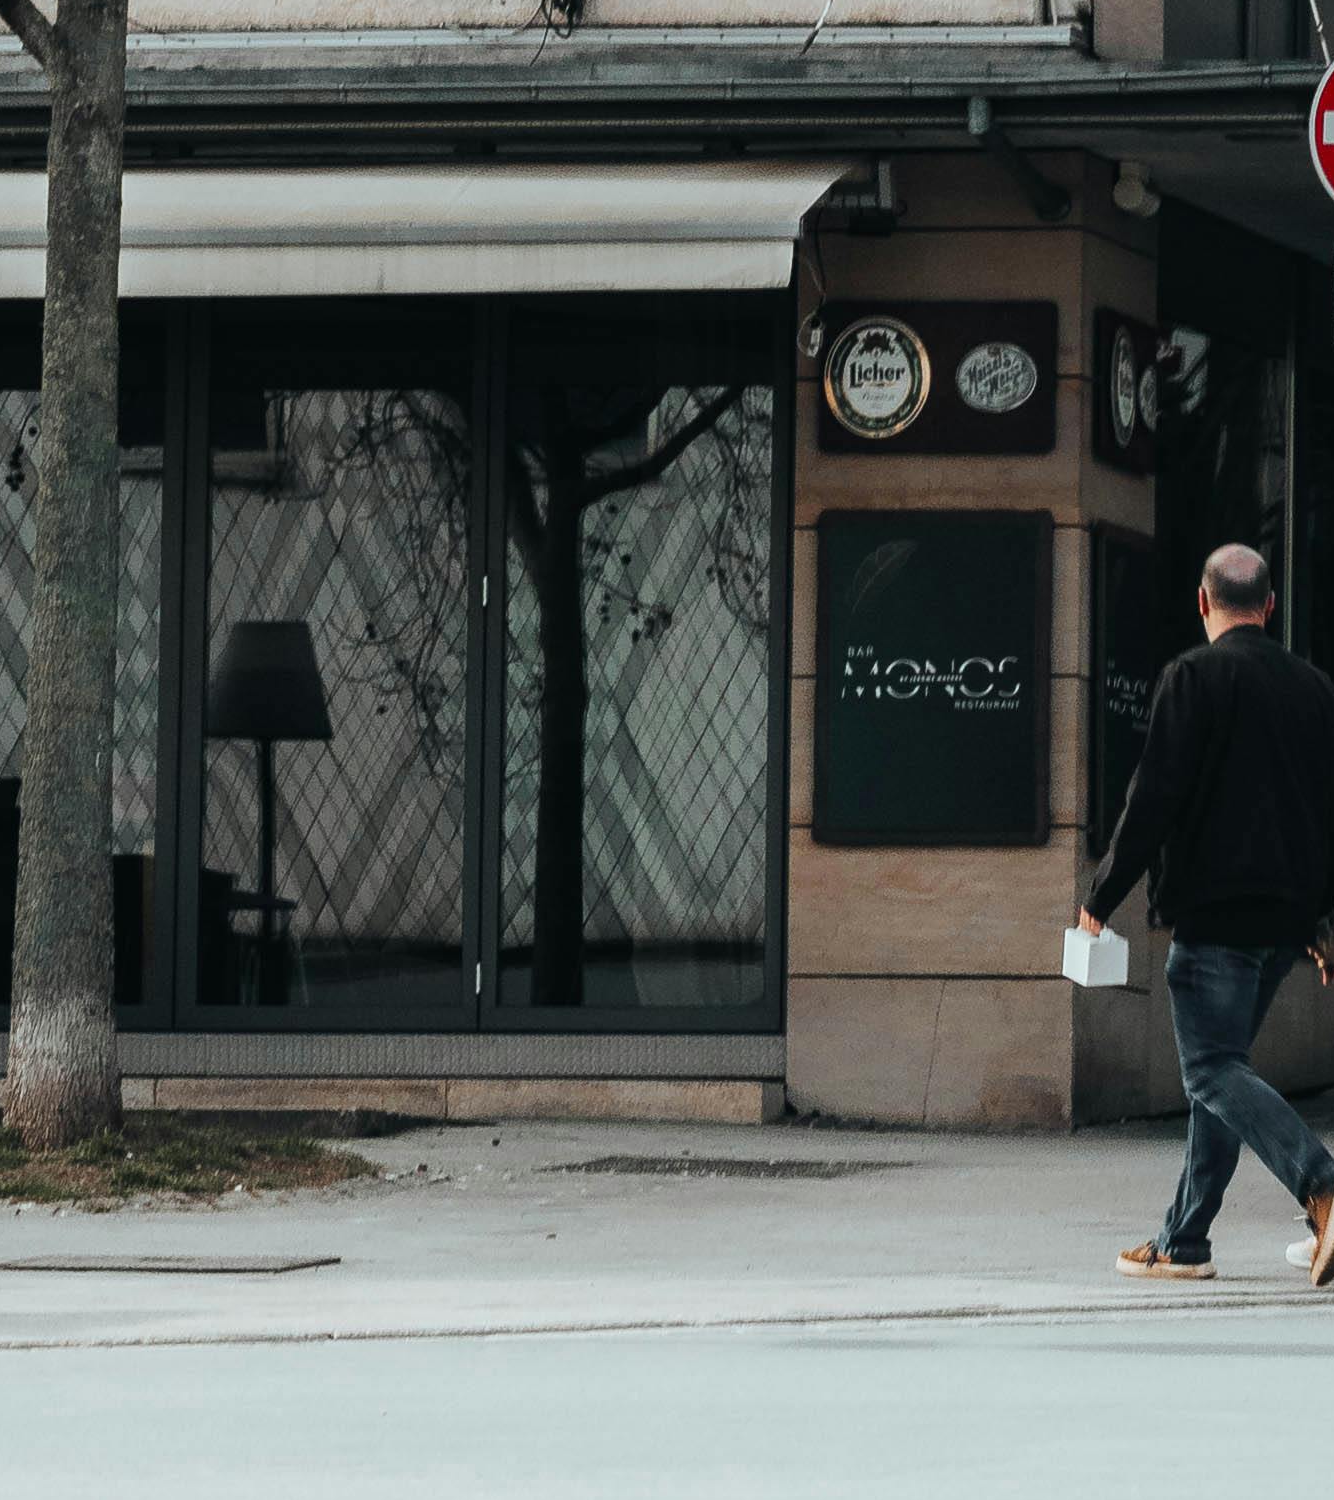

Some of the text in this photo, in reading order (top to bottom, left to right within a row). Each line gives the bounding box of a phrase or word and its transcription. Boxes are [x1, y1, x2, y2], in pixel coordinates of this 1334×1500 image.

[849, 360, 906, 389] Licher
[841, 656, 1021, 700] MONOS
[953, 700, 1021, 711] RESTAURANT
